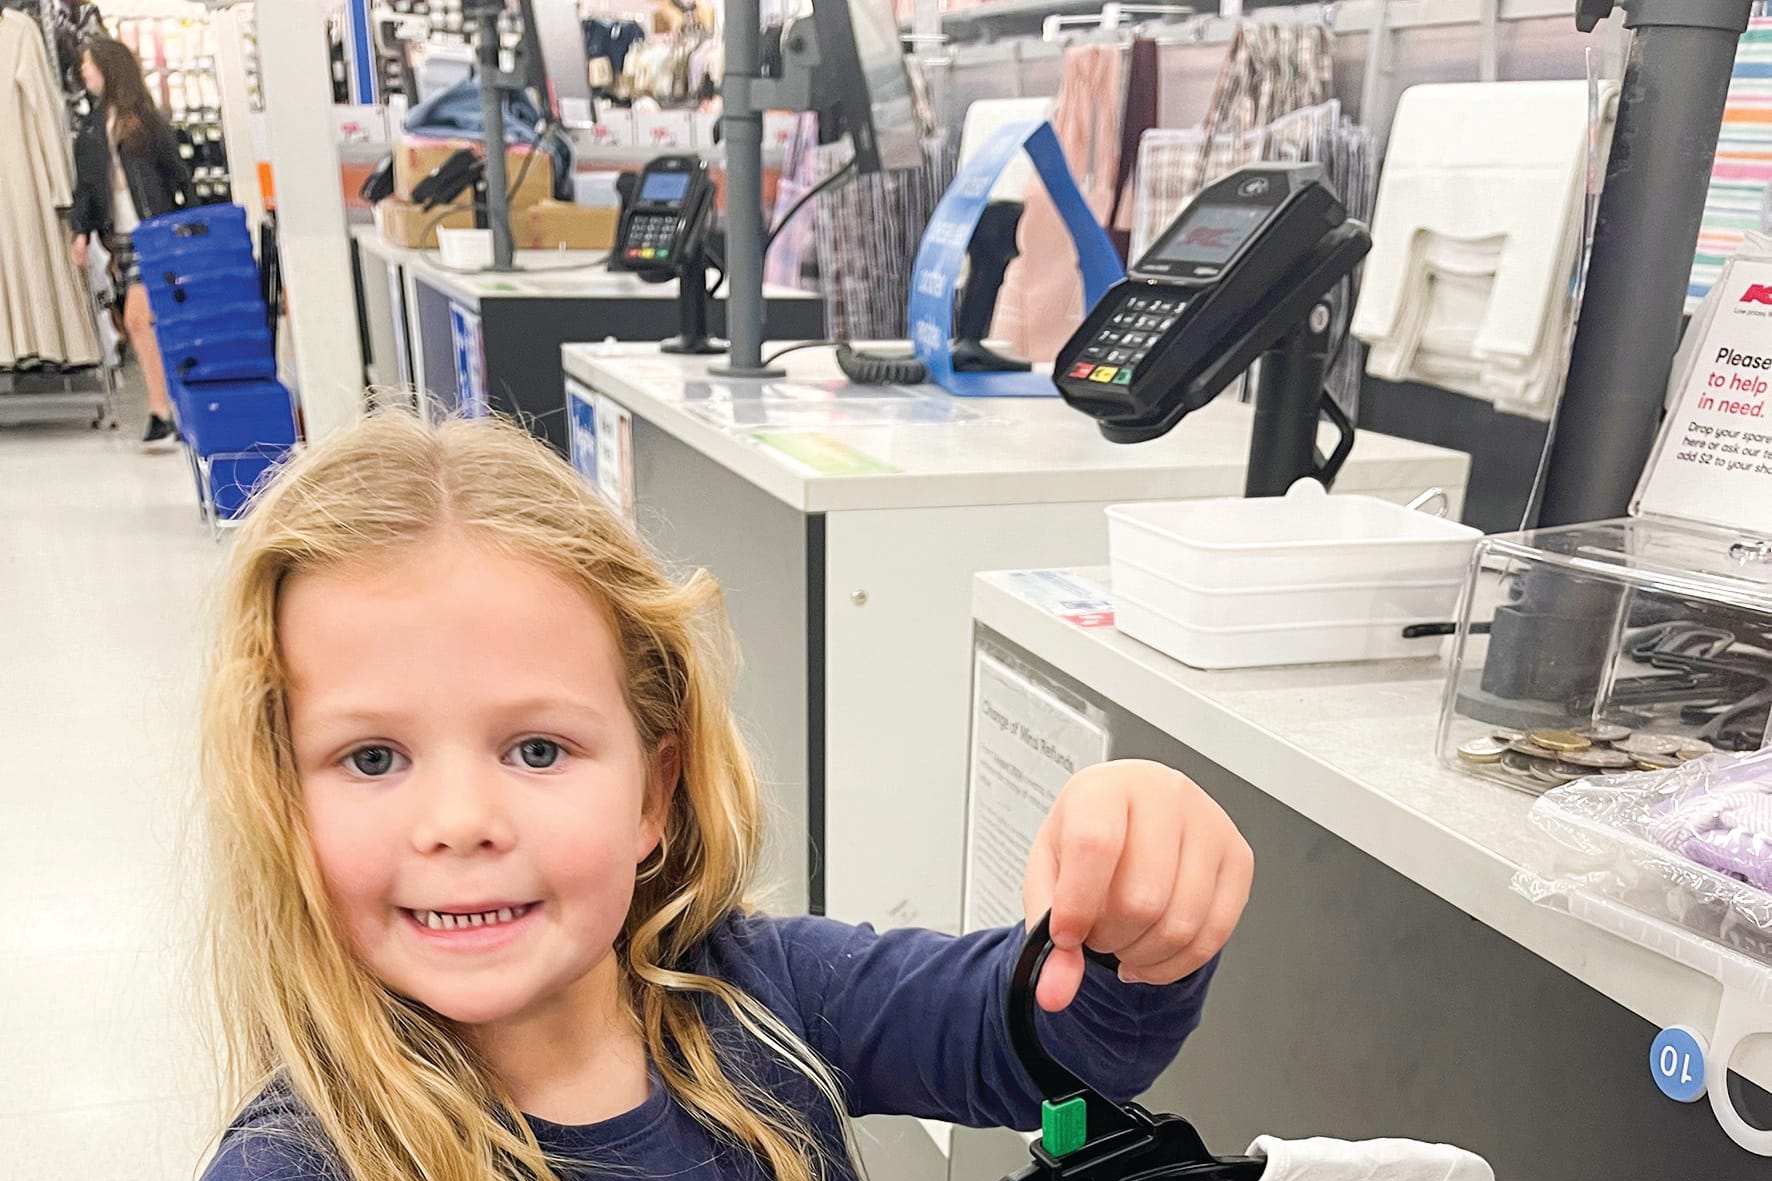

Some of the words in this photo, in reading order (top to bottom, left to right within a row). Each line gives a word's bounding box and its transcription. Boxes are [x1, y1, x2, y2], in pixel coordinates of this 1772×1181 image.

[1715, 347, 1772, 370] Please
[1707, 371, 1726, 388] to
[1729, 373, 1768, 397] help
[1697, 391, 1714, 410] in
[1718, 399, 1765, 418] need.
[1688, 421, 1714, 435] Drop
[1714, 427, 1741, 439] your
[1682, 436, 1707, 449] here
[1707, 441, 1720, 450] or
[1721, 442, 1741, 454] ask
[1742, 447, 1760, 457] our
[1676, 450, 1698, 461] add
[1714, 456, 1726, 467] to
[1726, 459, 1753, 471] your
